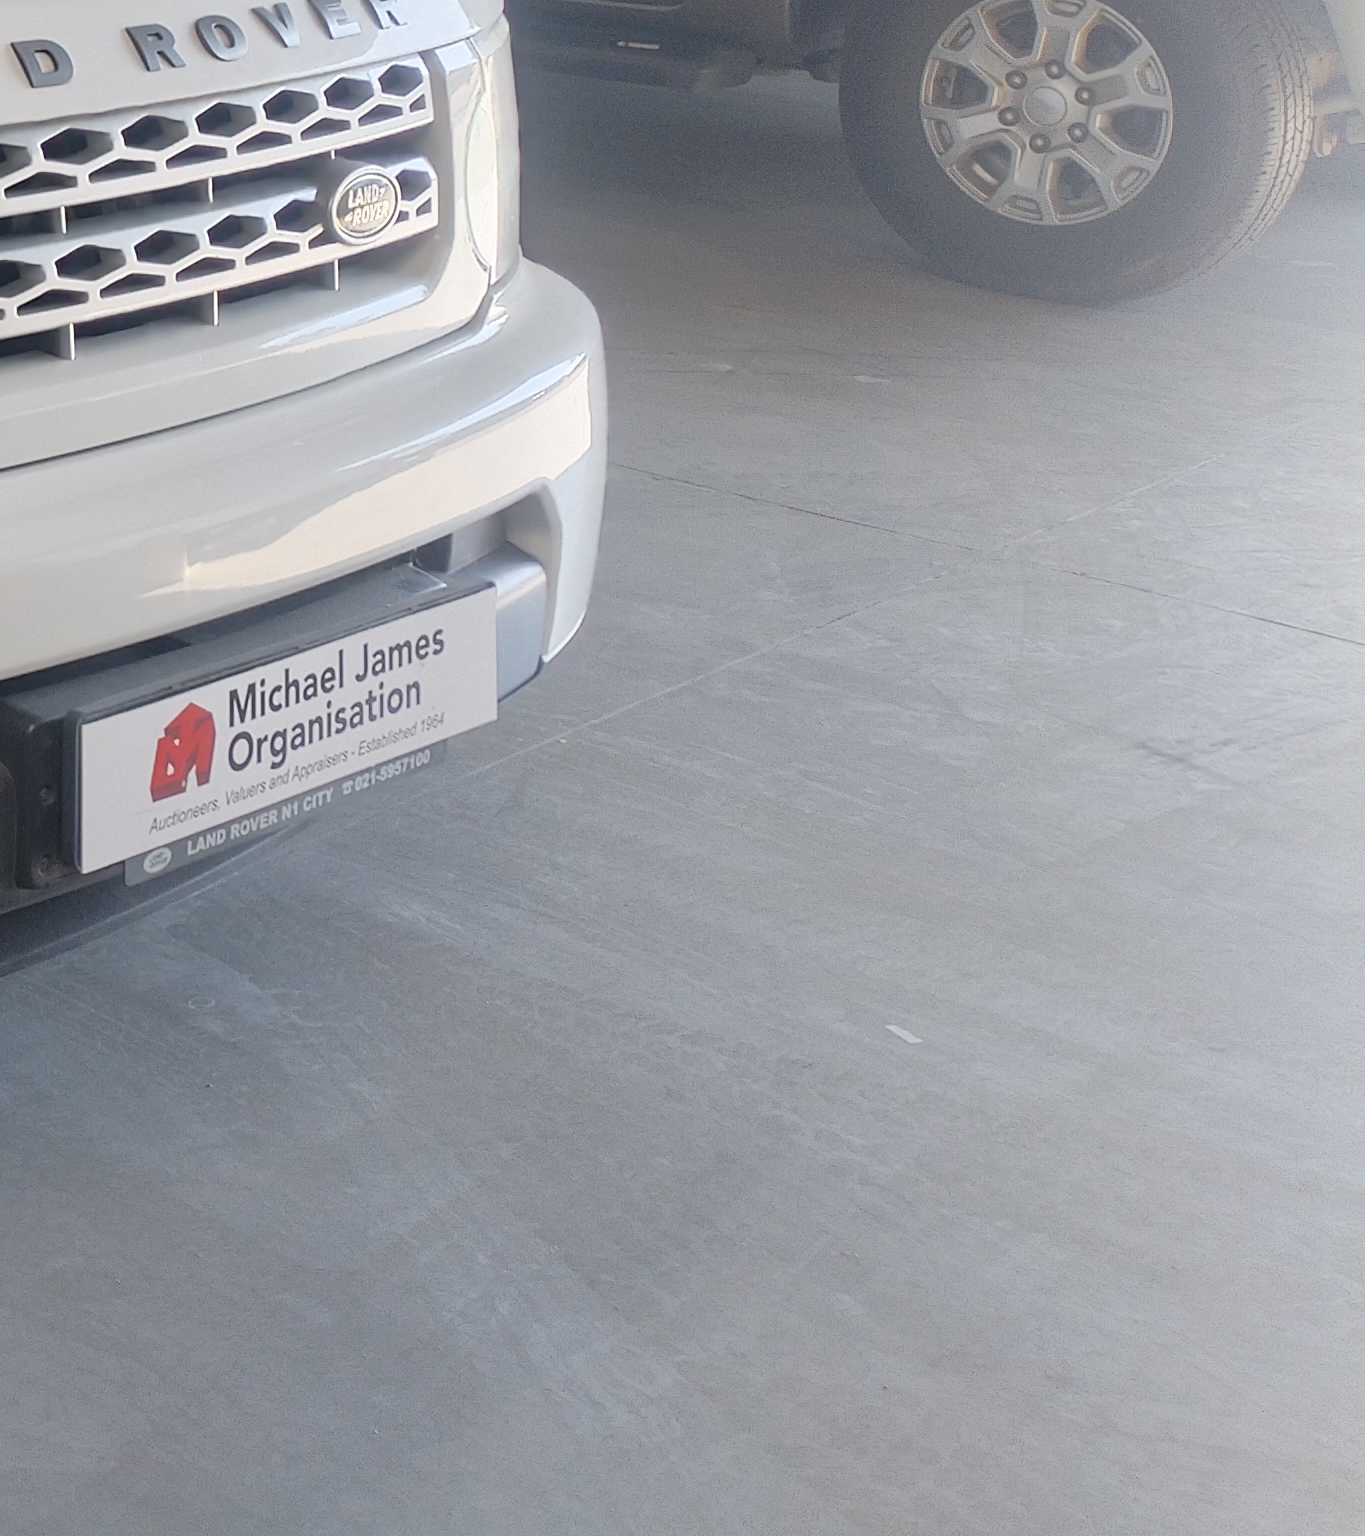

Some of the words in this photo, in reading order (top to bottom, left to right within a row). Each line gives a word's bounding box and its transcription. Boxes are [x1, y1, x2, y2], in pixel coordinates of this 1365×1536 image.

[347, 184, 380, 209] LAND
[352, 200, 389, 227] ROVER
[229, 649, 344, 728] Michael
[355, 629, 445, 683] James
[228, 680, 421, 772] Organisation
[148, 799, 220, 834] Auctioneers,
[225, 781, 267, 806] Valuers
[268, 769, 290, 791] and
[291, 750, 349, 783] Appraisers
[358, 721, 418, 756] Established
[187, 828, 226, 855] LAND
[230, 809, 279, 840] ROVER
[281, 801, 298, 821] N1
[303, 787, 334, 811] CITY
